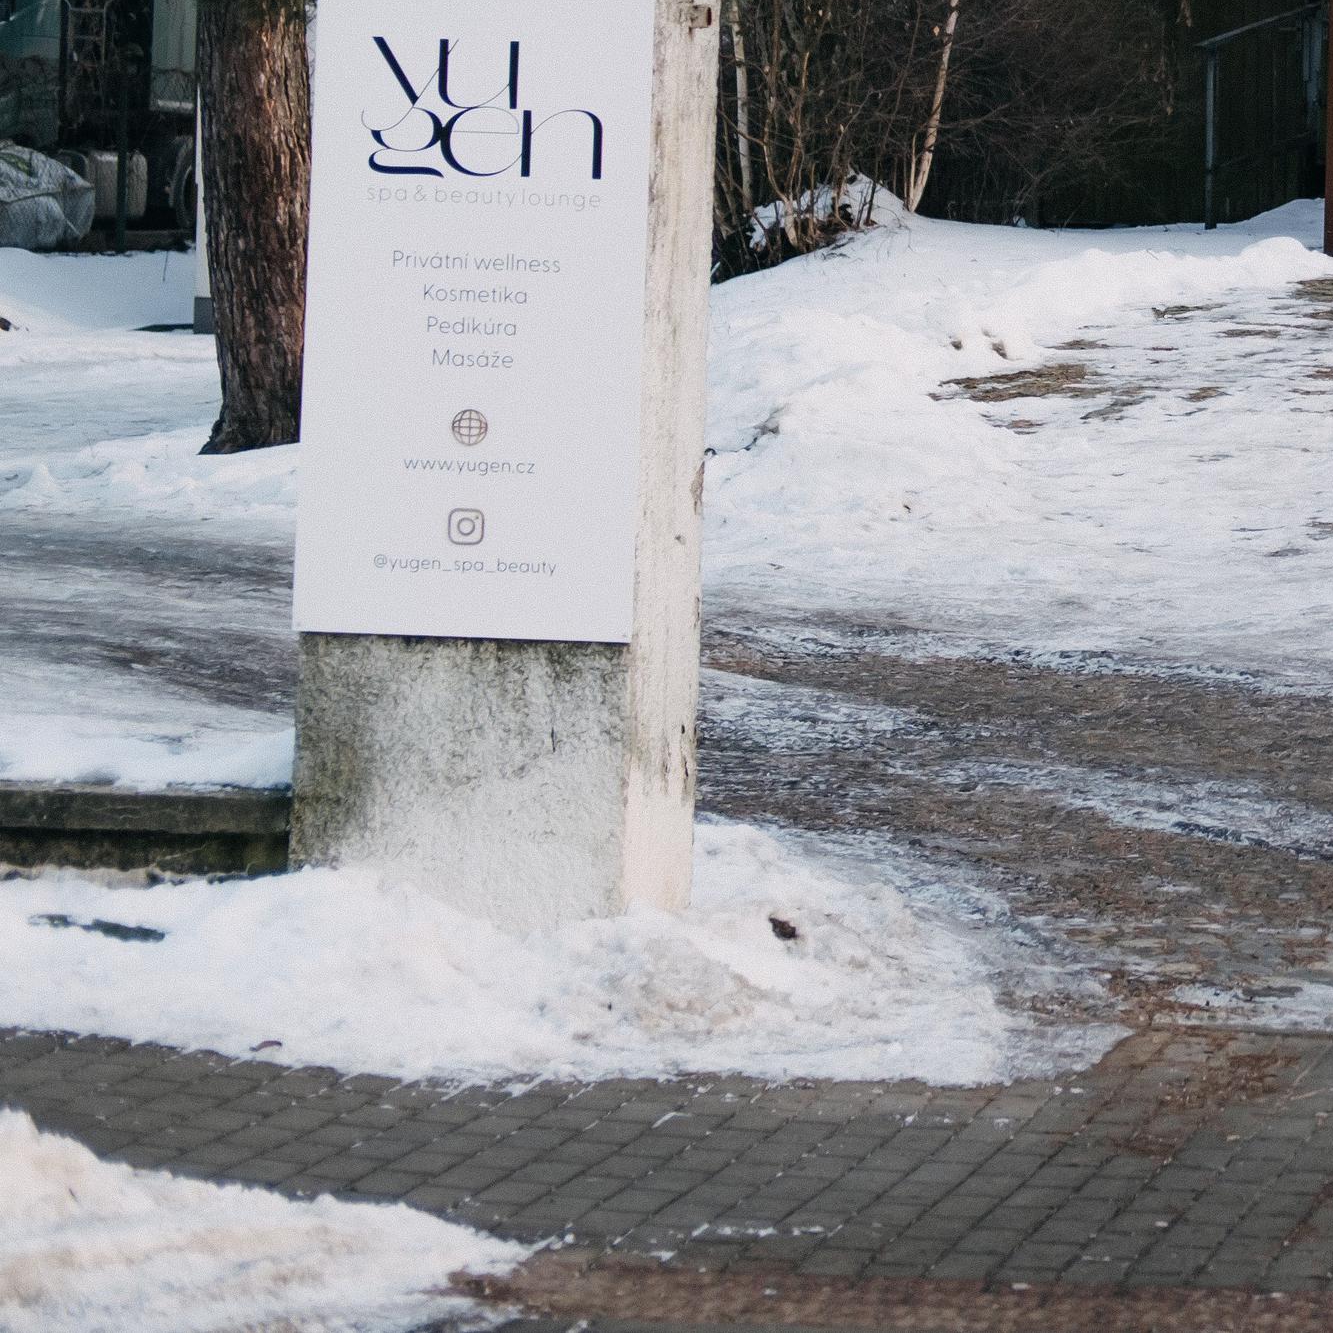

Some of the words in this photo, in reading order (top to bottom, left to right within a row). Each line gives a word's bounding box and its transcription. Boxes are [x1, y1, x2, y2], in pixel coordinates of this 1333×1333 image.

[361, 36, 519, 132] yu
[368, 106, 603, 179] gen
[366, 185, 408, 204] spa
[413, 185, 428, 203] &
[434, 185, 517, 207] beauty
[522, 188, 601, 212] lounge
[393, 249, 470, 270] Privátní
[474, 253, 561, 274] wellness
[423, 283, 528, 305] Kosmetika
[427, 315, 517, 337] Pedikúra
[432, 348, 514, 369] Masáže
[403, 458, 536, 476] www.yugen.cz
[373, 553, 557, 576] @yugen_spa_beauty
